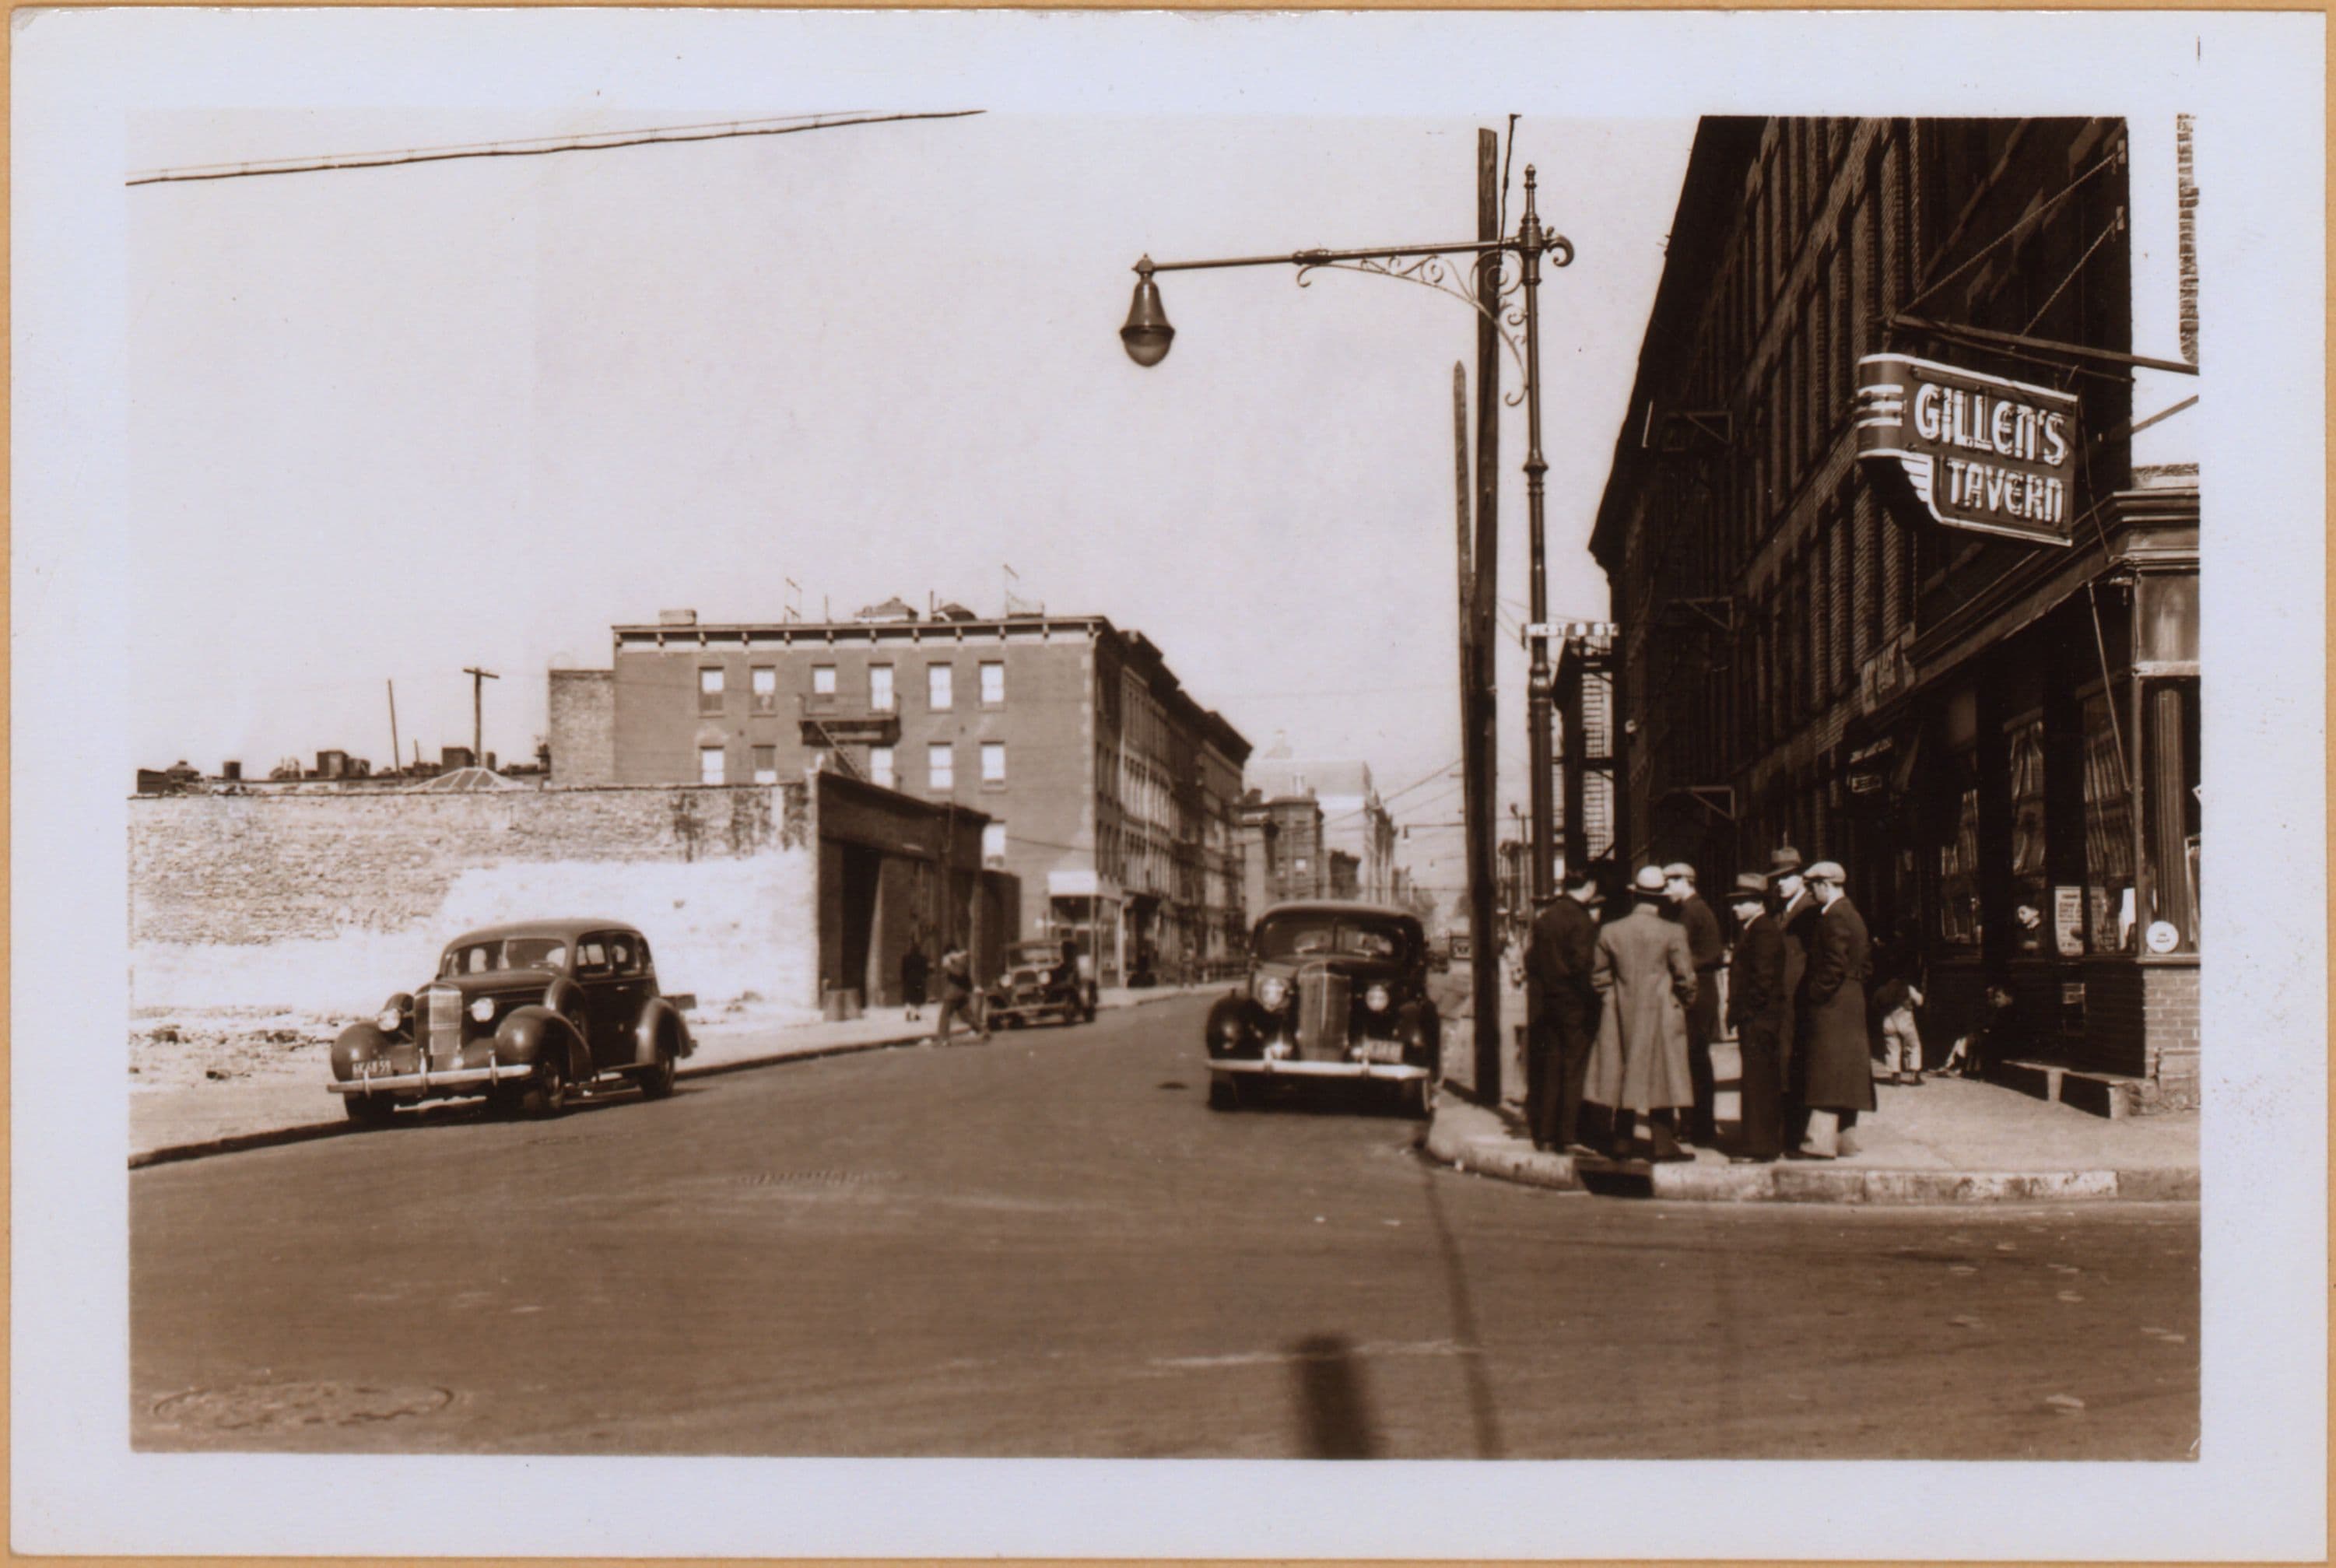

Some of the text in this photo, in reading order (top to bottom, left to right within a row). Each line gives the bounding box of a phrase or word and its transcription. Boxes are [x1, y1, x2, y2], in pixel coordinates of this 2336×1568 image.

[1914, 384, 2068, 466] GILLEN'S
[1947, 461, 2063, 524] TAVERN
[1527, 623, 1567, 637] WEST
